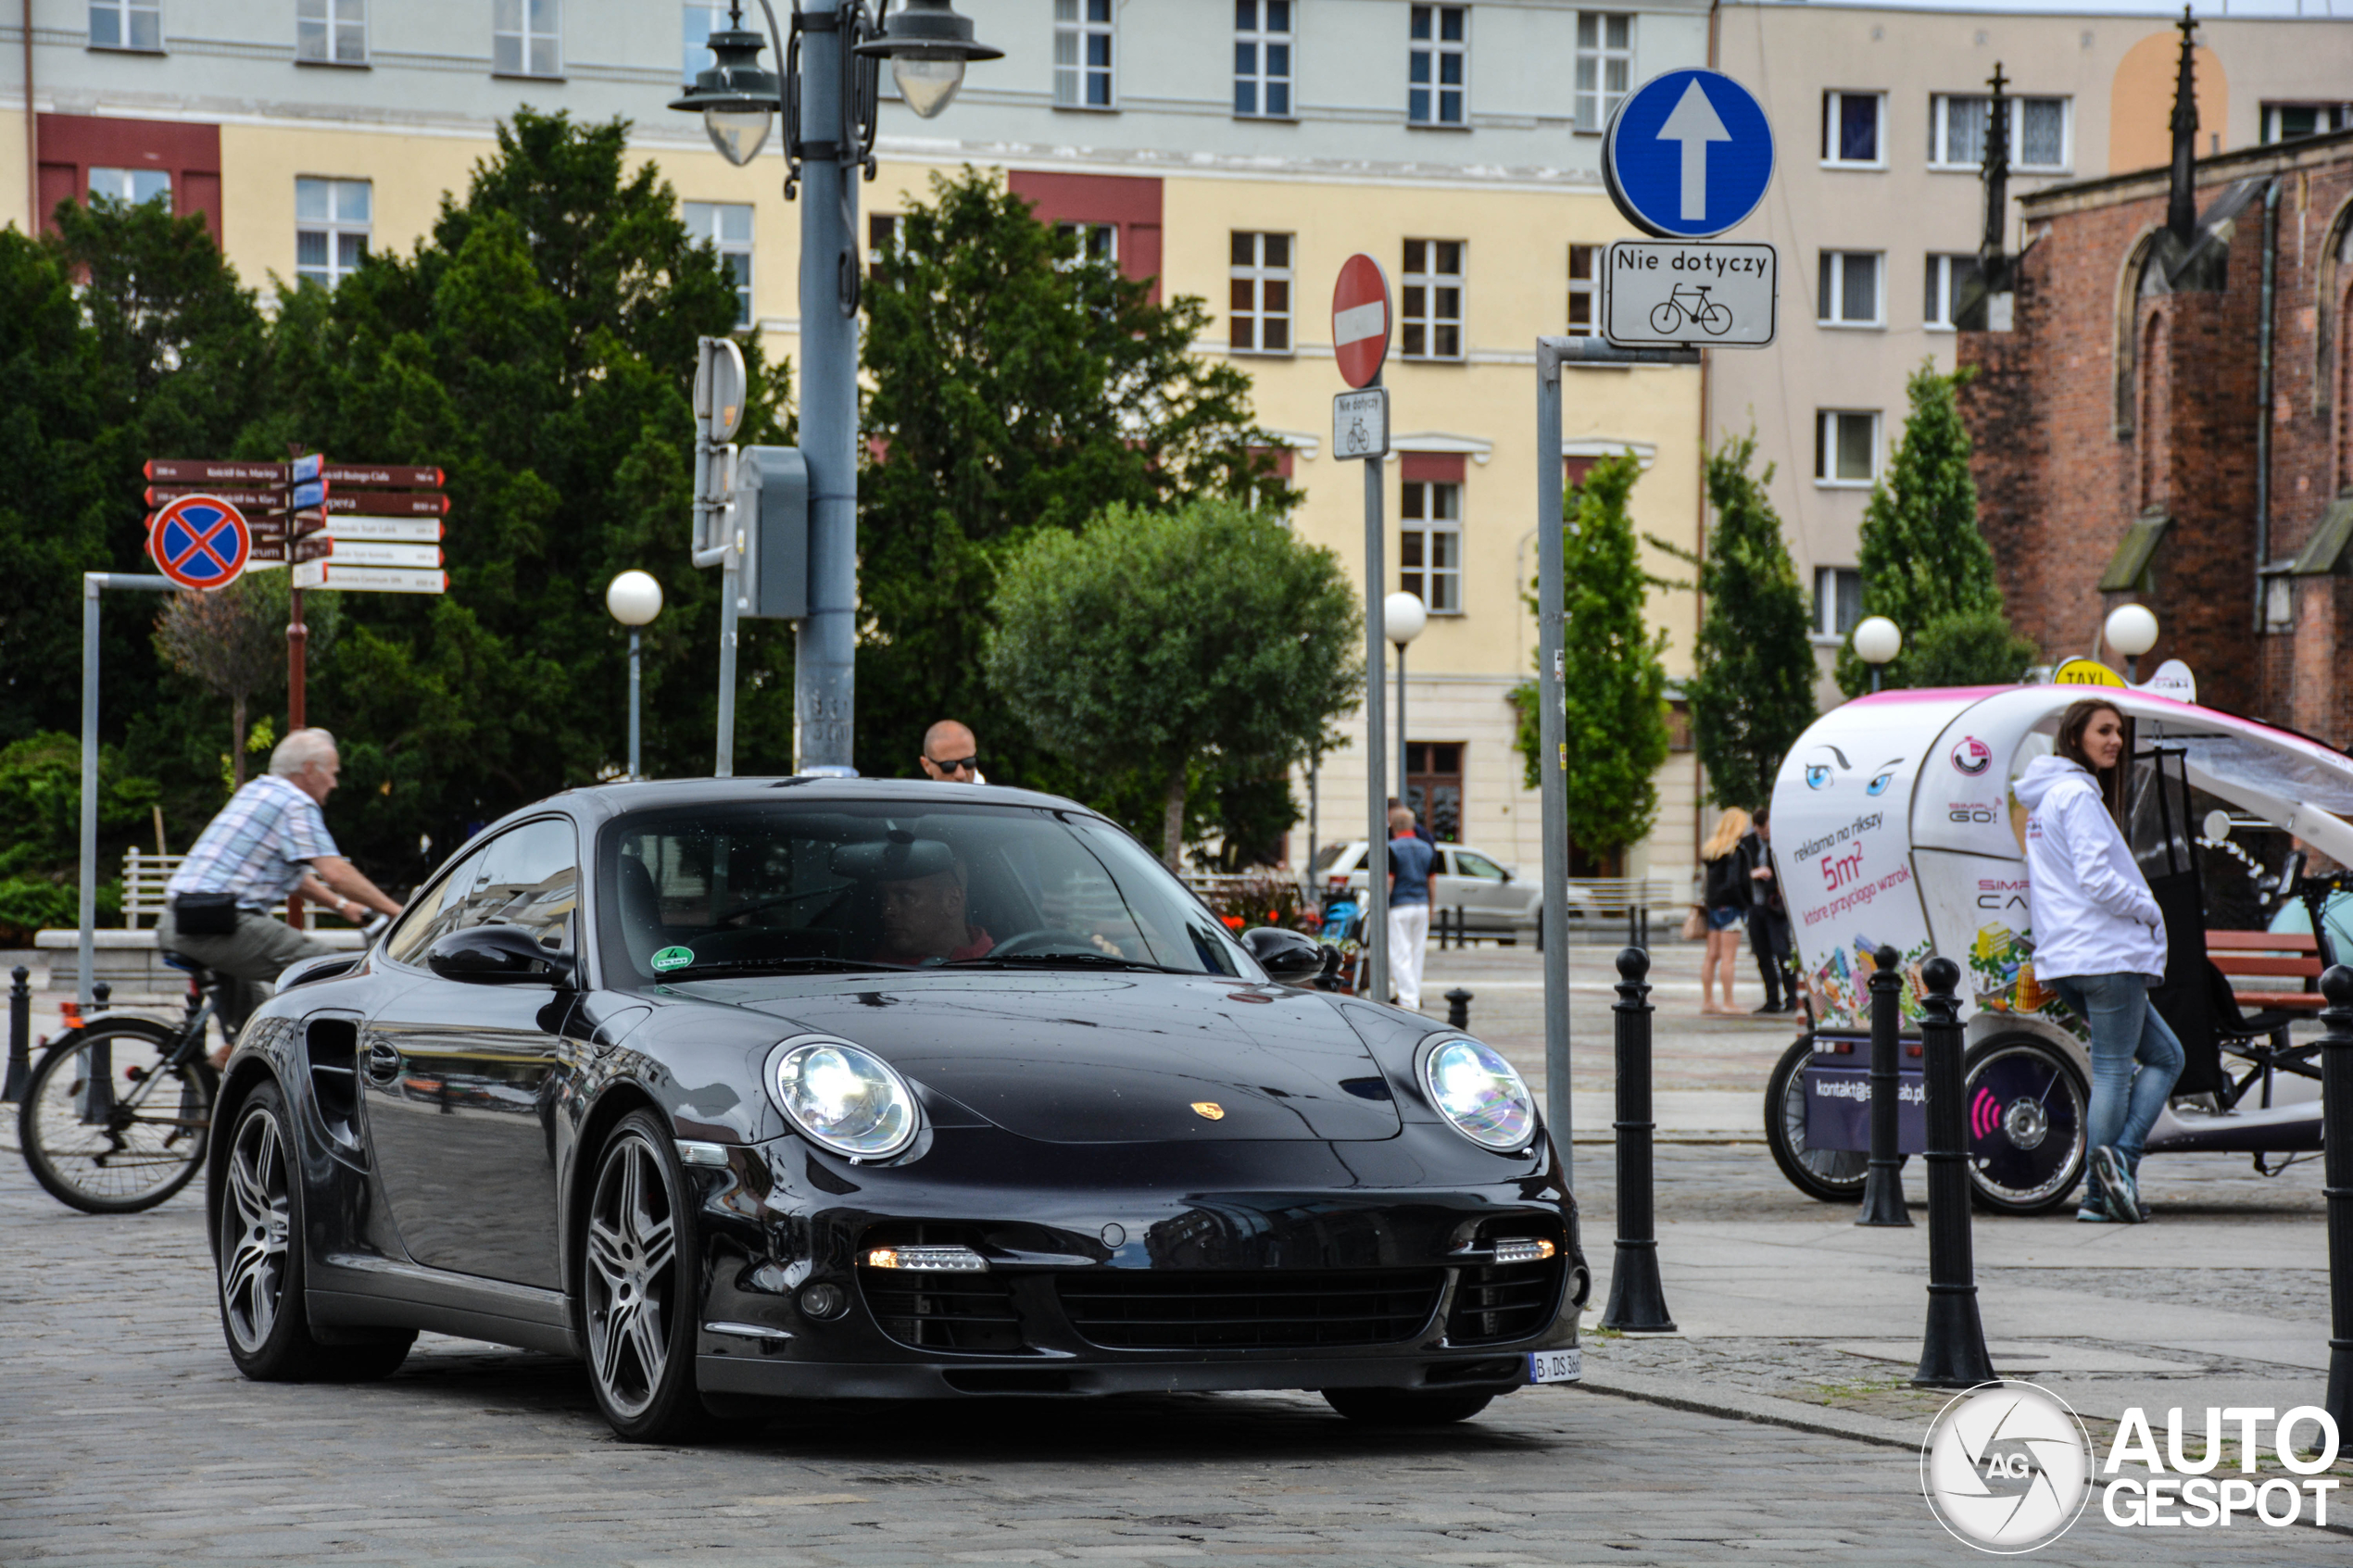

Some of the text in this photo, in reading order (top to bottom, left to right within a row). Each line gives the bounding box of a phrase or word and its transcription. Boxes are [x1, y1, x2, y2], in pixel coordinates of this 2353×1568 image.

[1617, 249, 1767, 278] Nie dotyczy
[1339, 396, 1378, 413] Nie dotyczy
[326, 497, 356, 510] pera
[2067, 671, 2103, 684] TAXI
[1949, 810, 1997, 823] GO!
[1793, 811, 1883, 863] reklama na rikszy
[1979, 879, 2030, 890] SIMP
[1802, 905, 1830, 927] które
[1877, 863, 1911, 892] wzrok
[667, 947, 678, 959] 4
[1536, 1358, 1545, 1378] B
[1552, 1356, 1567, 1376] DS
